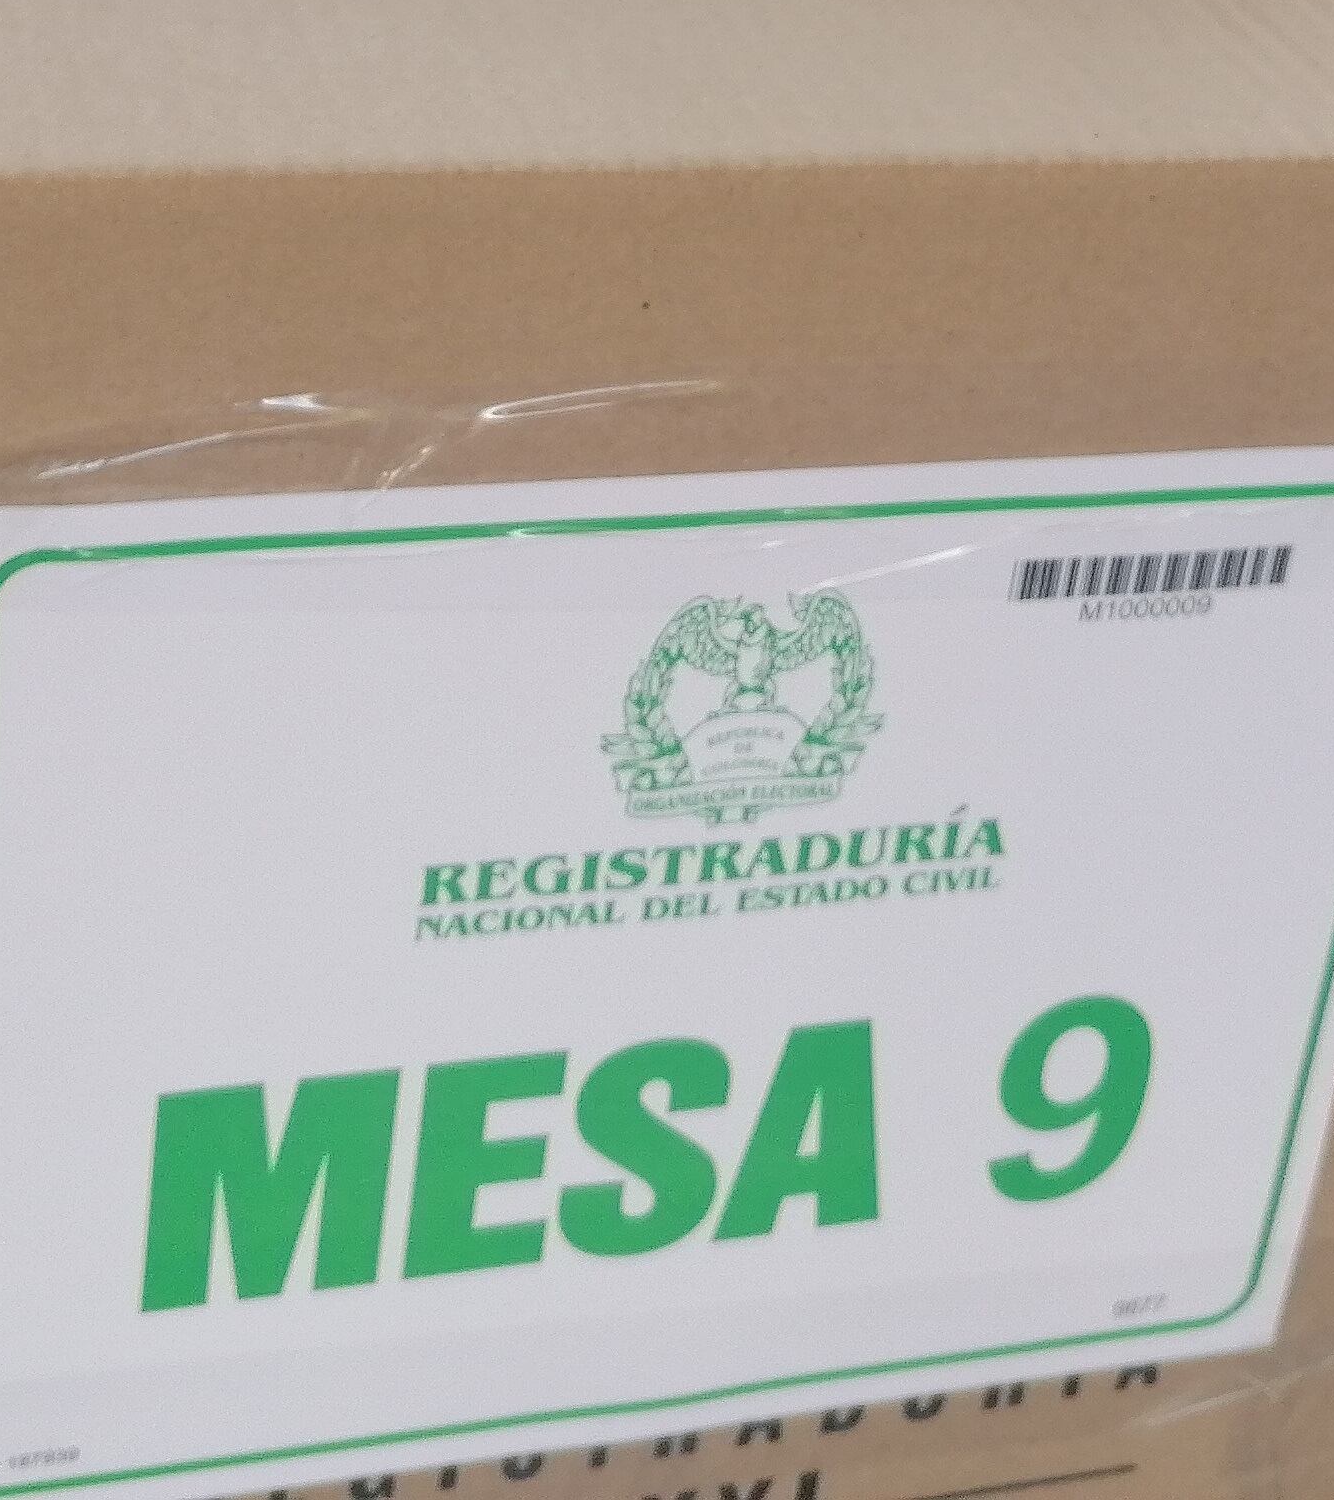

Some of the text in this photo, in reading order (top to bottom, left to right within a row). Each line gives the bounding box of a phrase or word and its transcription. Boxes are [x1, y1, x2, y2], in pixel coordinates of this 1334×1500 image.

[1077, 595, 1213, 622] M1000009
[420, 804, 1006, 907] REGISTRADURÍA
[415, 865, 1001, 942] NACIONAL DEL ESTADO CIVIL
[140, 992, 1152, 1312] MESA 9
